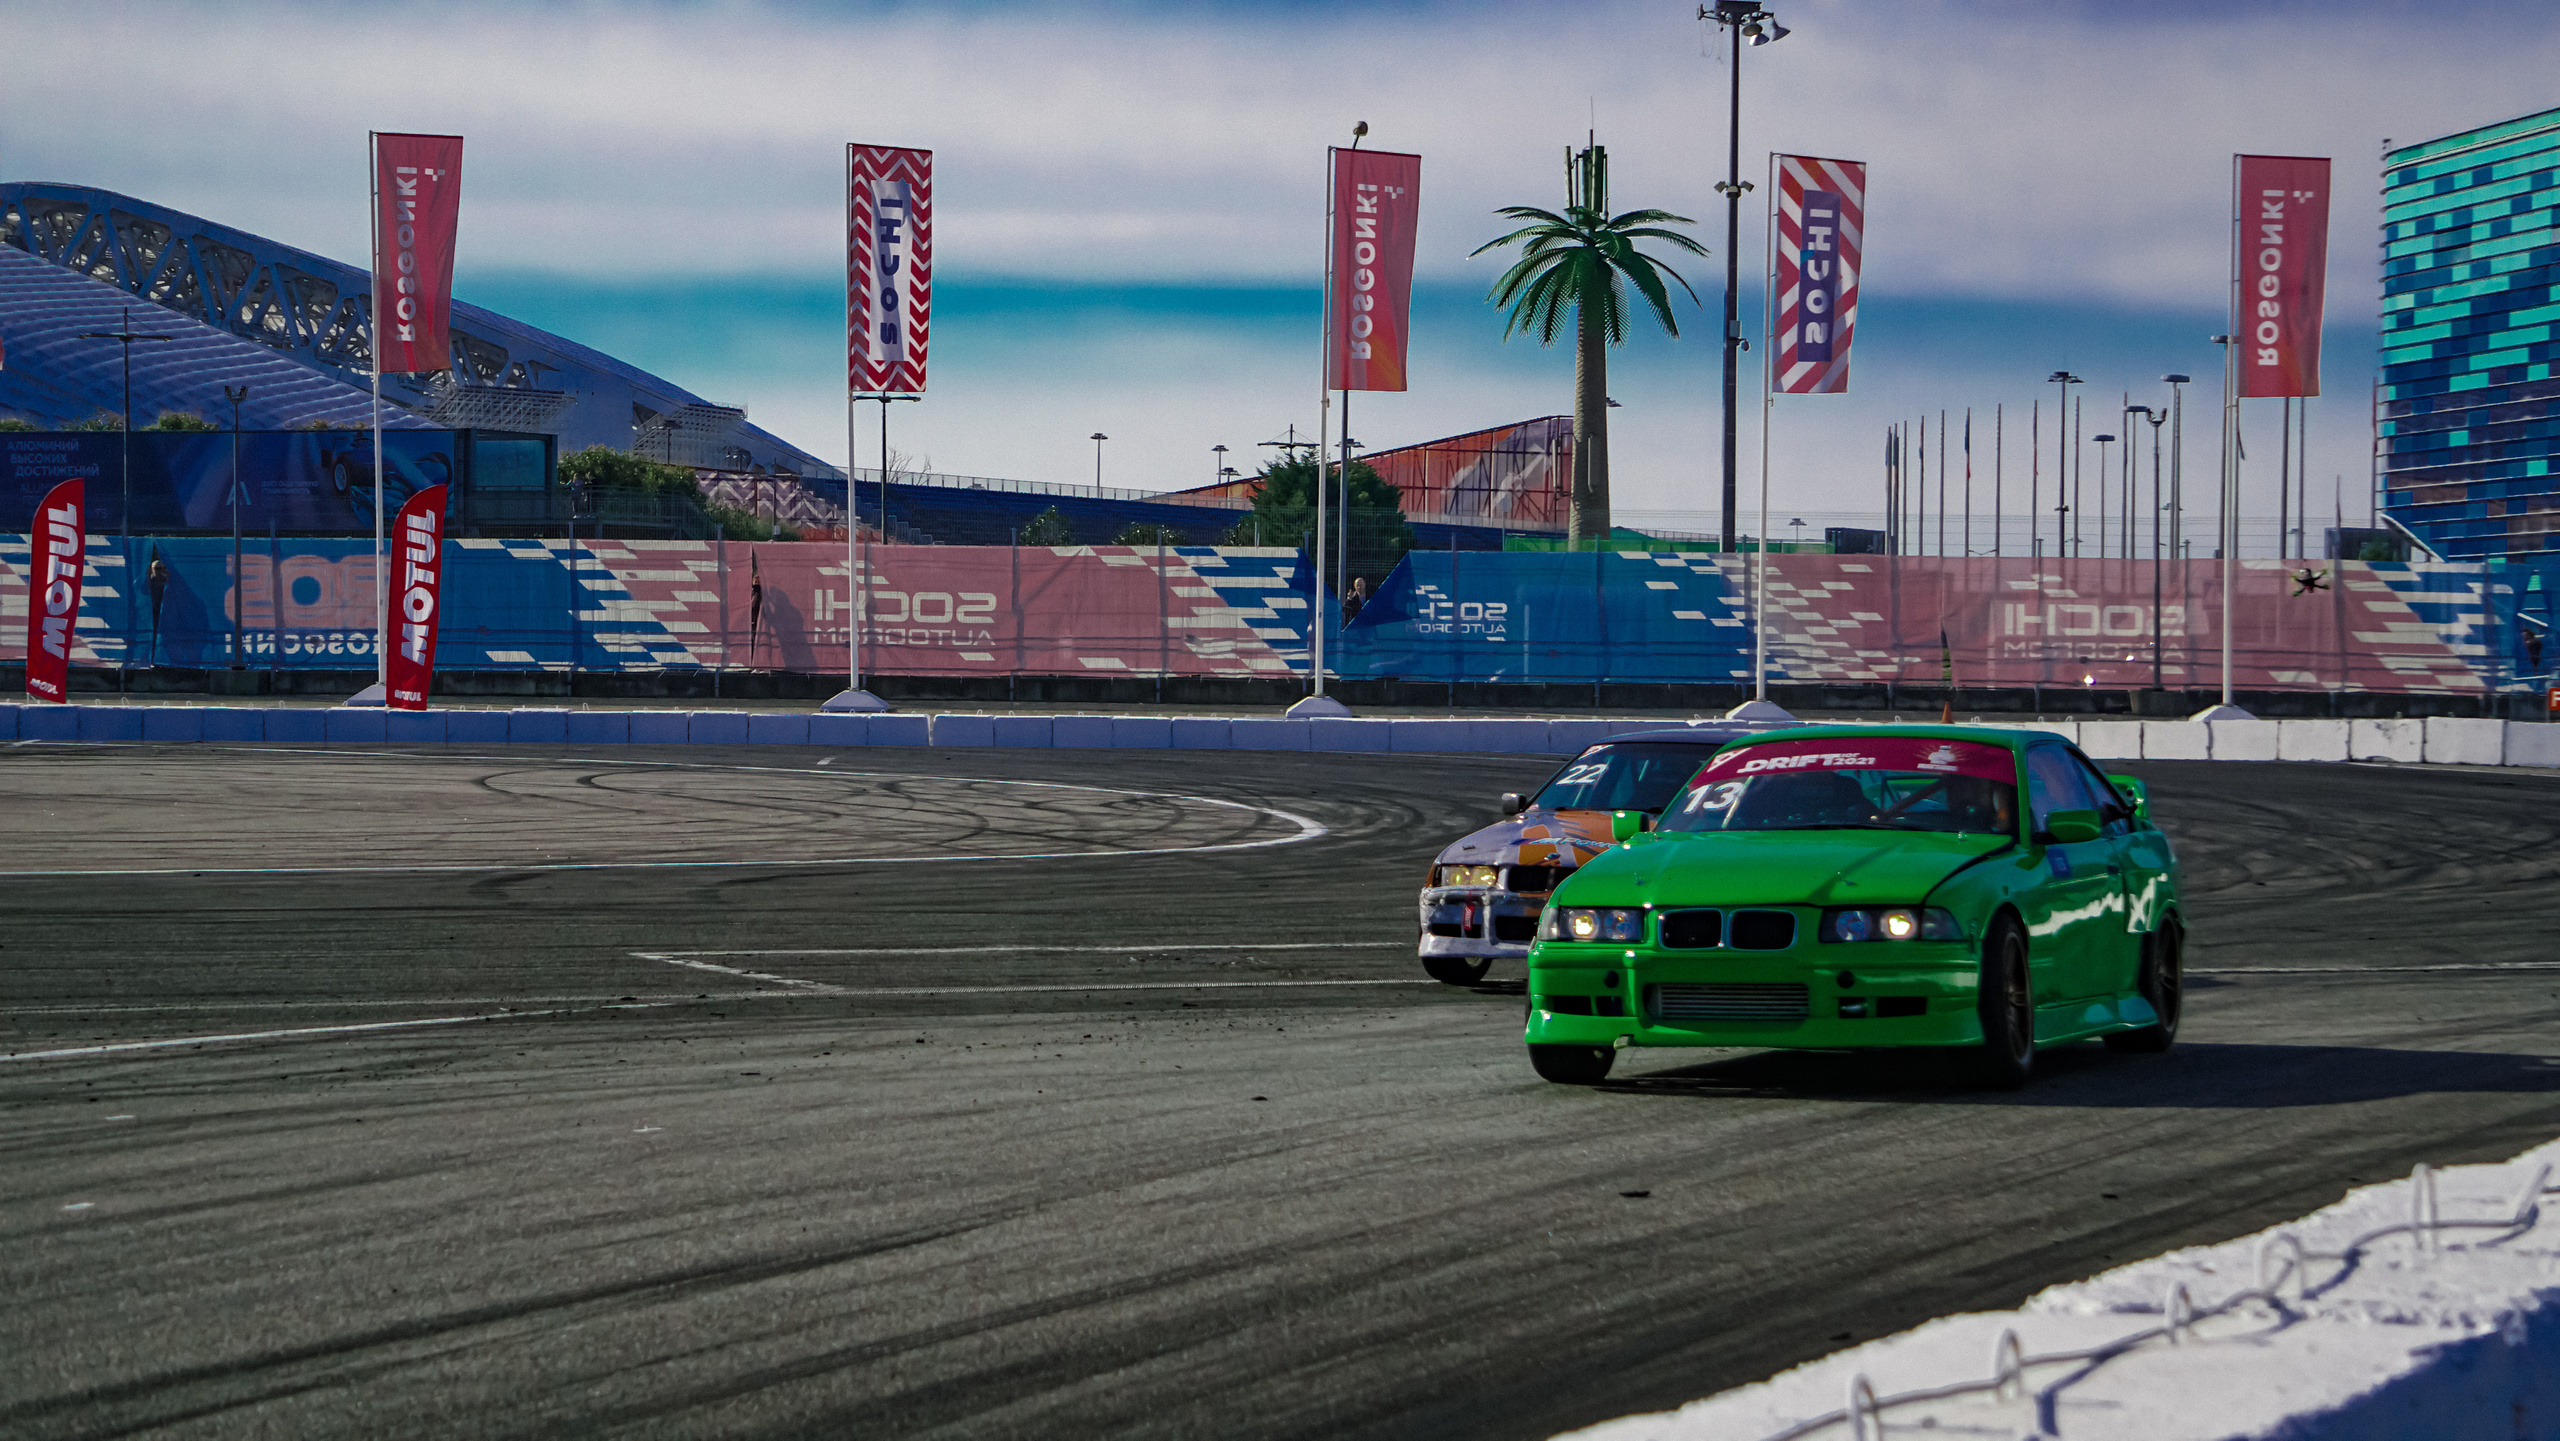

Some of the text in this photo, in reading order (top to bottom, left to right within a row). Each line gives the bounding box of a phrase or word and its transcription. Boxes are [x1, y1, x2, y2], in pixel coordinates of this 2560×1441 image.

[7, 438, 79, 451] АЛЮМИНИЙ
[10, 453, 67, 464] ВЫСОКИХ
[14, 464, 100, 478] ДОСТИЖЕНИЙ
[42, 502, 78, 660] MOTUL
[400, 508, 436, 666] MOTUL
[1736, 753, 1841, 773] DRIFT
[1832, 757, 1876, 766] 2021
[1555, 764, 1607, 786] 22
[1683, 782, 1744, 814] 13
